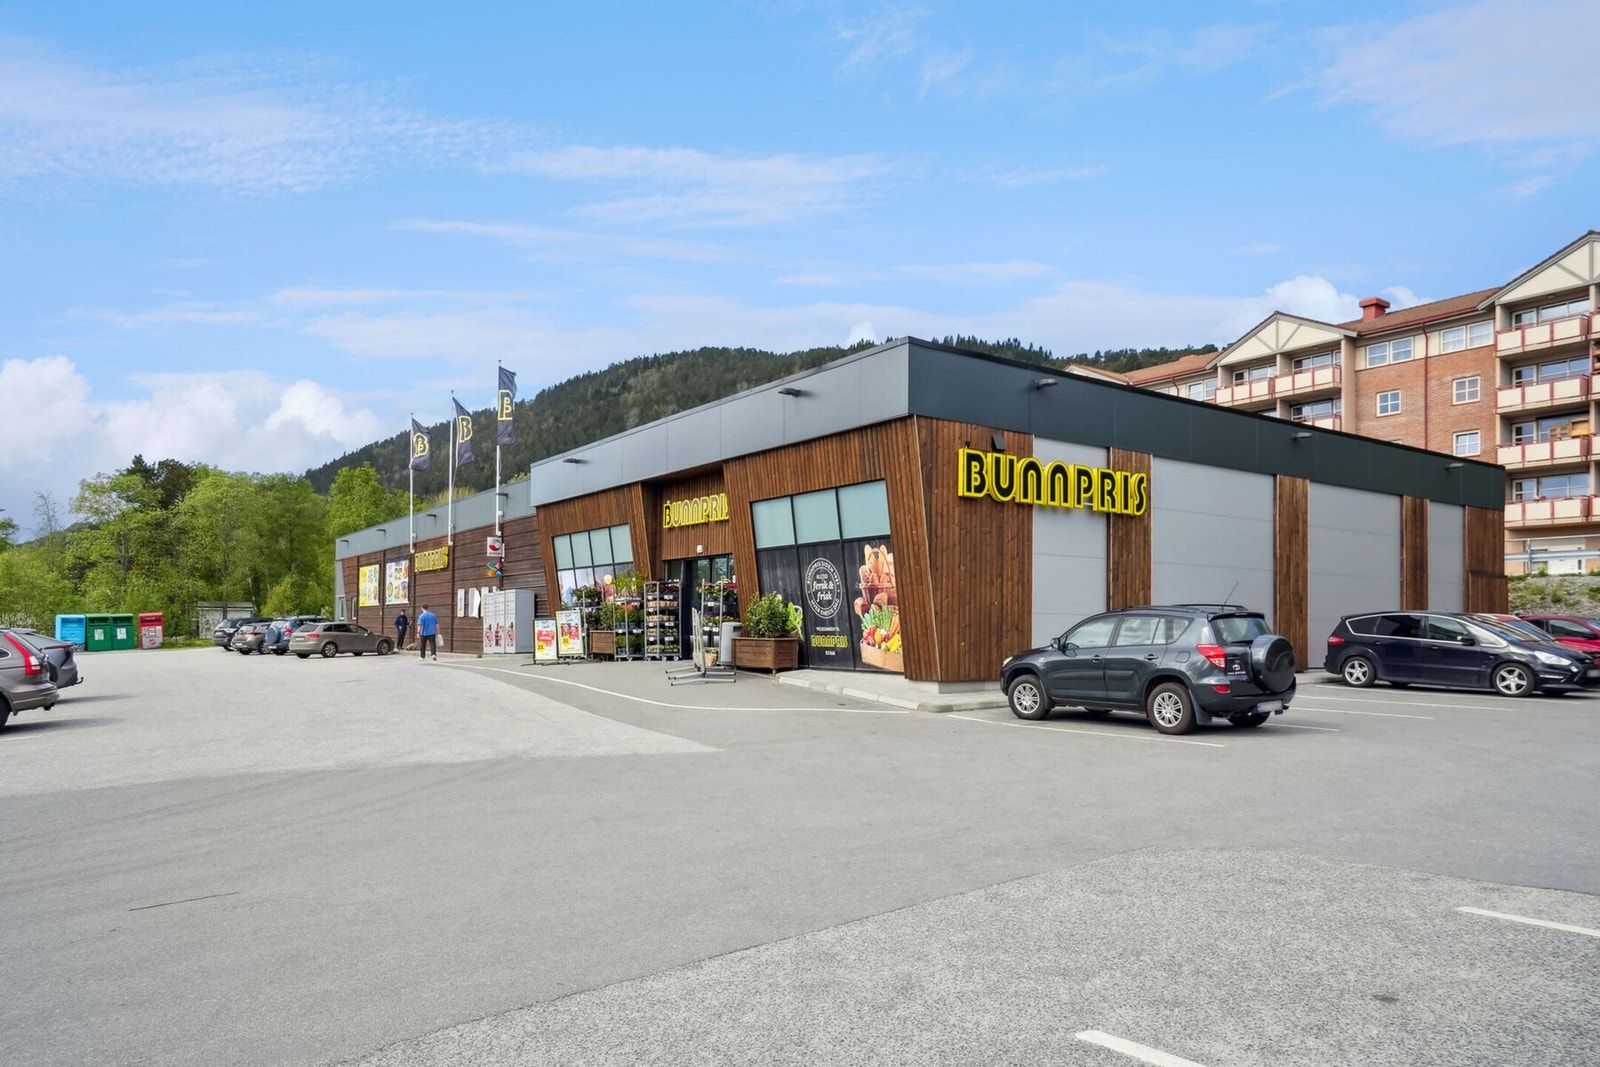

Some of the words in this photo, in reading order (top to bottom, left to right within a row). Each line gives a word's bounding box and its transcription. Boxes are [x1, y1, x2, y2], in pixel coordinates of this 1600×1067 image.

[458, 416, 473, 442] B
[413, 433, 429, 457] B
[958, 448, 1147, 516] BUNNPRIS
[663, 493, 730, 528] BUNNPRI
